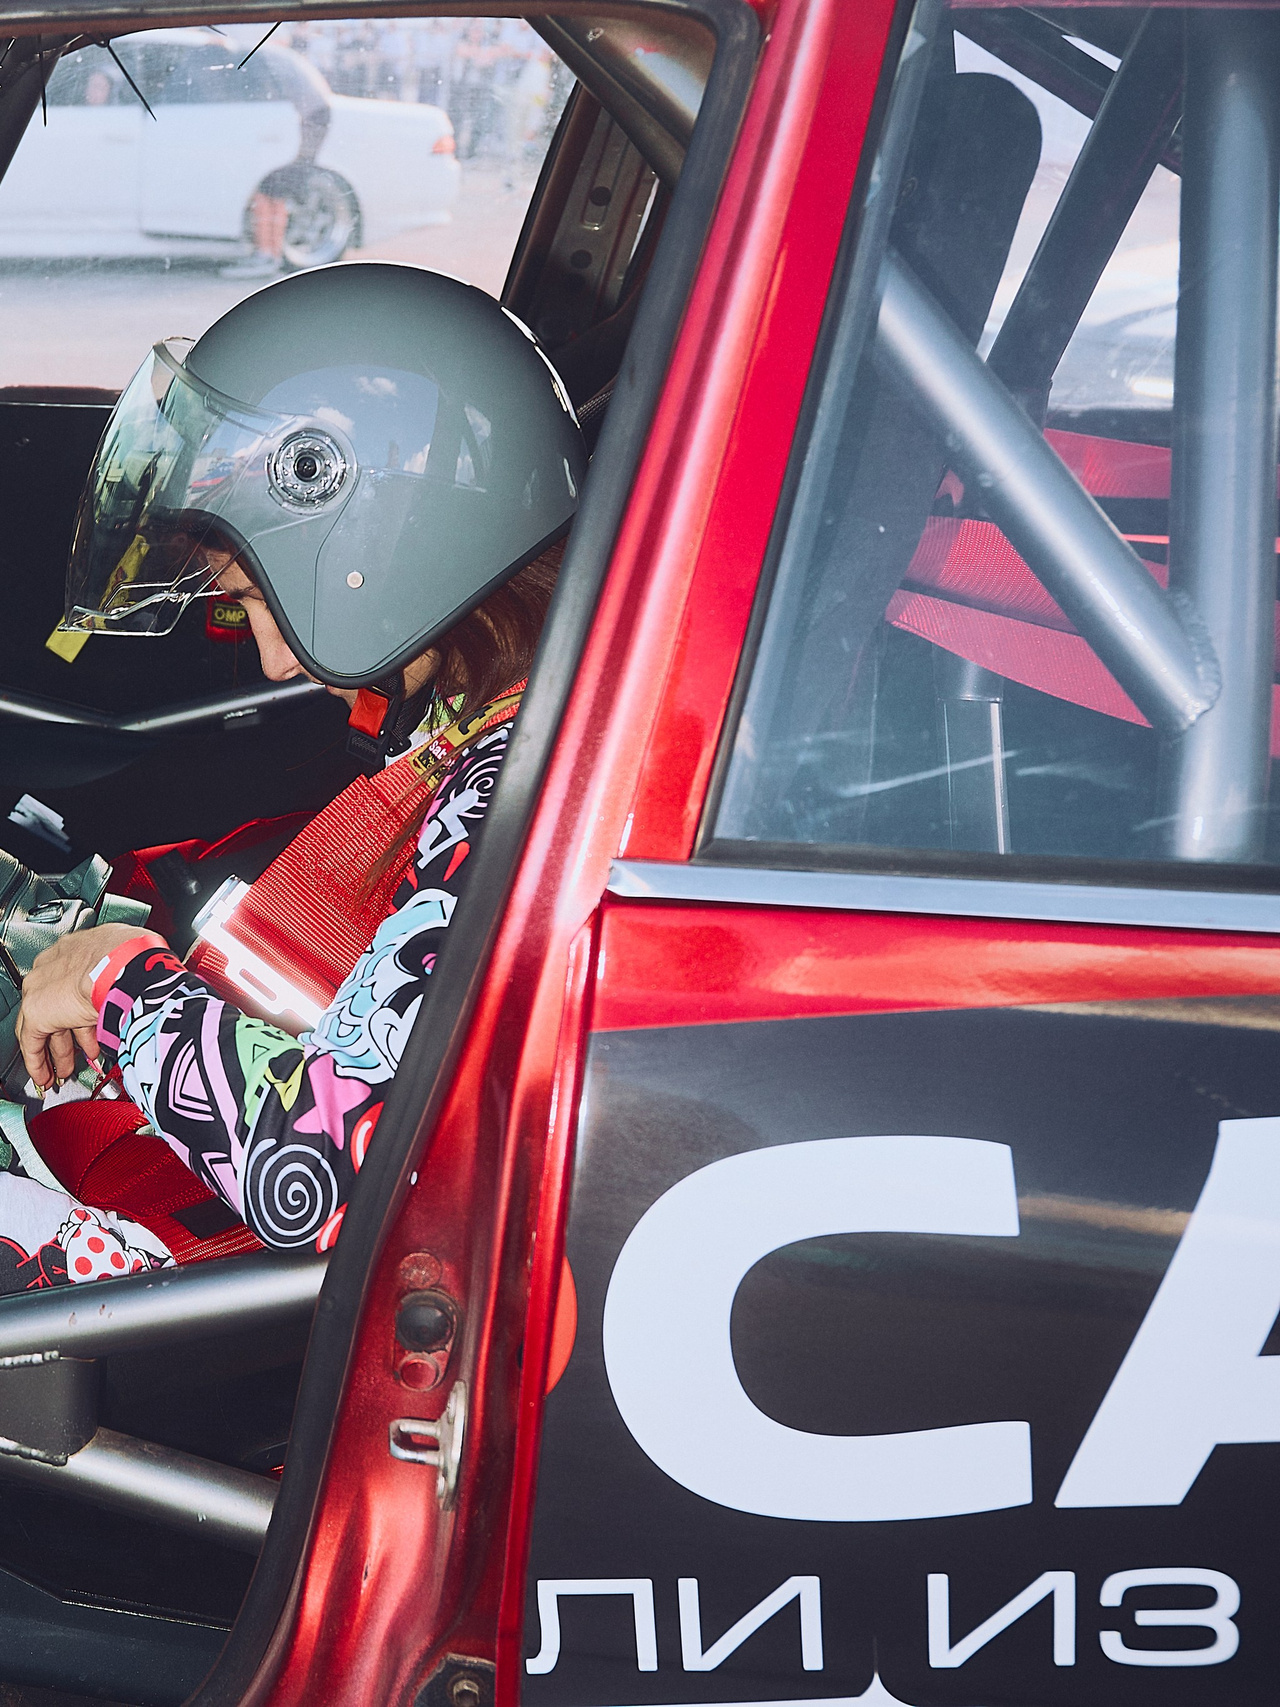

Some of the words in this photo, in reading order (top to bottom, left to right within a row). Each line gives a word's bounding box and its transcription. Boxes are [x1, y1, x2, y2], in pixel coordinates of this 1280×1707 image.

[214, 608, 246, 623] OMP
[525, 1575, 825, 1676] ЛИ
[926, 1566, 1241, 1669] ИЗ
